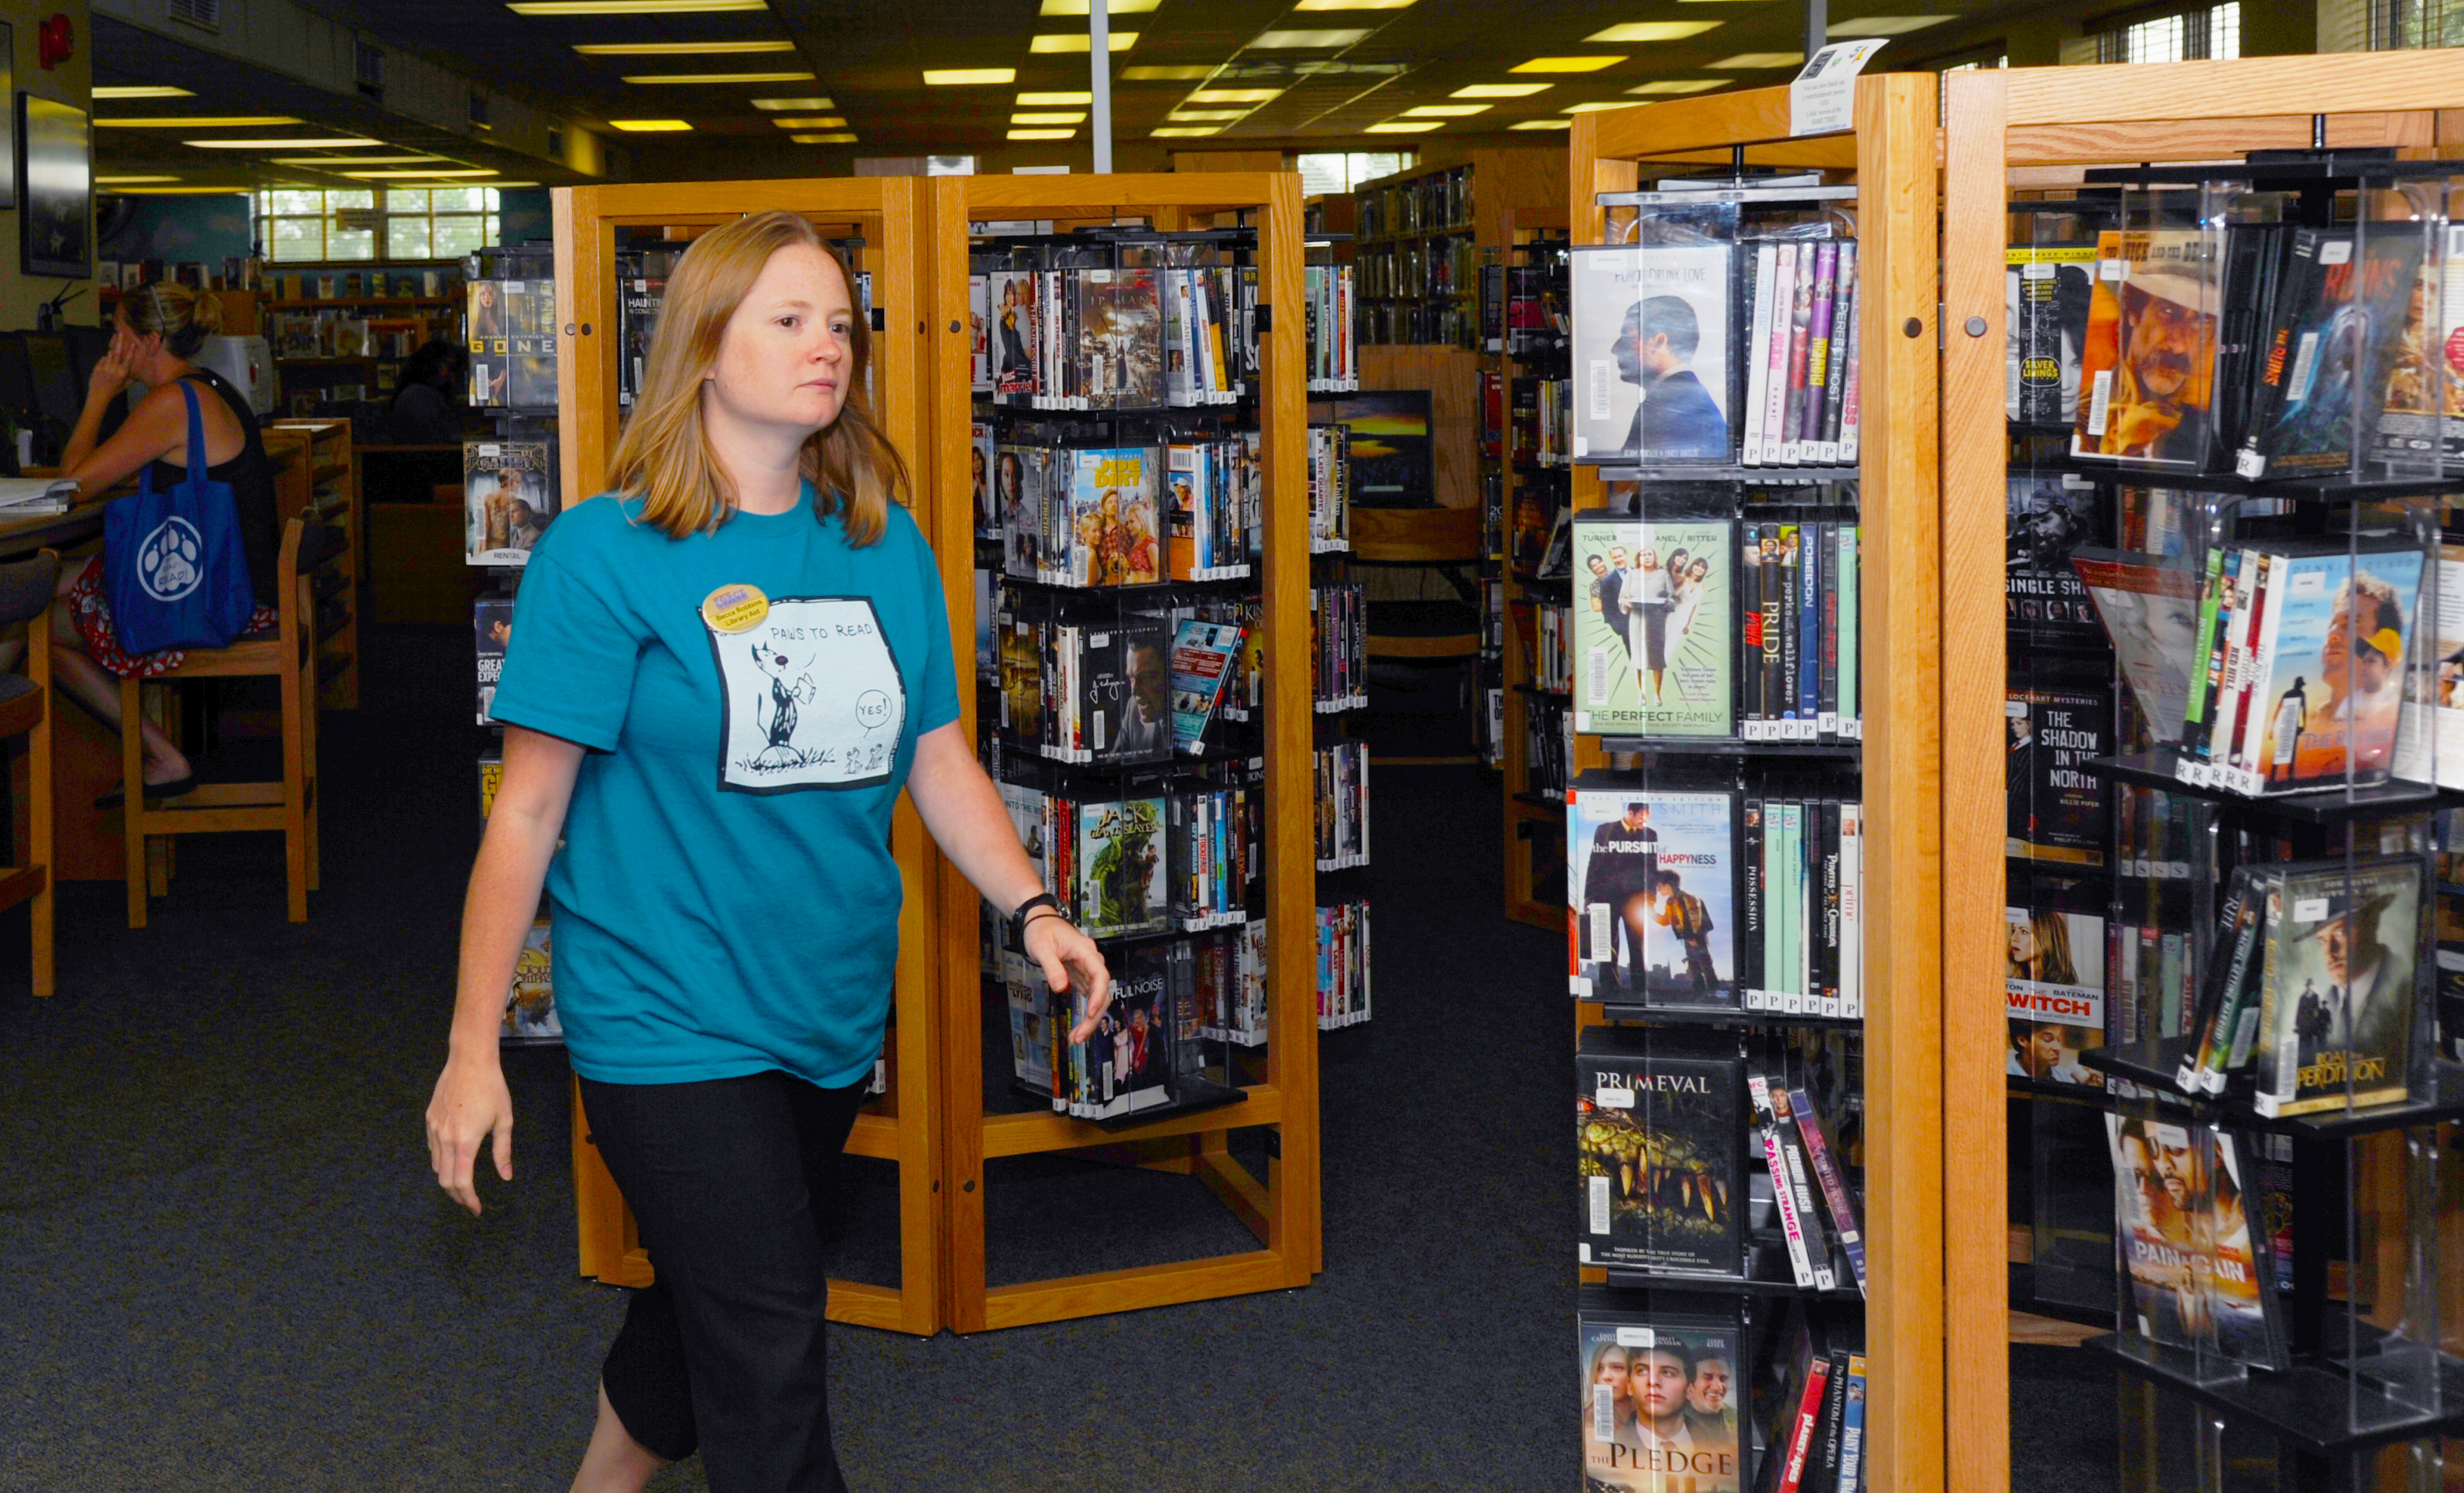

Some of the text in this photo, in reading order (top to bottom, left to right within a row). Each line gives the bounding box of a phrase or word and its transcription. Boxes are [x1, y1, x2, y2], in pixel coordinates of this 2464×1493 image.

[1683, 267, 1706, 282] LOVE
[1090, 295, 1105, 306] IP
[469, 340, 555, 354] GONE
[1828, 301, 1849, 404] PERFECT HOST
[1184, 347, 1193, 372] EYRE
[2025, 360, 2055, 369] SILVER
[1749, 448, 1757, 459] P
[1767, 447, 1775, 458] P
[1787, 448, 1796, 459] P
[1805, 445, 1814, 456] P
[1825, 447, 1833, 458] P
[1844, 442, 1852, 454] P
[1094, 459, 1142, 474] JOE
[2239, 457, 2250, 473] R
[1094, 472, 1143, 488] DIRT
[1804, 536, 1814, 608] POSEIDON
[2005, 579, 2056, 594] SINGLE
[716, 599, 763, 622] Becca Robbins
[725, 608, 761, 627] Library Aid
[770, 623, 873, 641] PAWS TO READ
[1763, 601, 1780, 664] PRIDE
[1783, 581, 1795, 704] perks wallflower
[2190, 617, 2206, 678] ROSEMARY'S
[2223, 646, 2240, 690] RED HILL
[858, 697, 888, 717] YES!
[2008, 693, 2099, 706] LOCKHART MYSTERIES
[1584, 710, 1723, 723] THE PERFECT FAMILY
[1826, 717, 1835, 728] P
[2047, 711, 2072, 728] THE
[1749, 725, 1757, 736] P
[1767, 725, 1777, 736] P
[1784, 724, 1793, 735] P
[1804, 724, 1812, 735] P
[1845, 723, 1853, 733] P
[2041, 729, 2098, 750] SHADOW
[2303, 731, 2332, 749] THE
[2055, 750, 2070, 765] IN
[2178, 764, 2186, 776] R
[2193, 767, 2202, 779] R
[2212, 768, 2221, 781] R
[2226, 771, 2235, 784] R
[2050, 769, 2097, 789] NORTH
[2240, 775, 2250, 789] R
[1098, 805, 1150, 827] JACK
[1660, 803, 1722, 815] SMITH
[1089, 822, 1158, 840] GIANT SLAYER
[1592, 841, 1609, 854] the
[1609, 841, 1658, 854] PURSUIT
[1659, 854, 1718, 865] HAPPYNESS
[1747, 865, 1756, 932] POSSESSION
[1826, 852, 1840, 948] PIRATES CARIBBEAN
[1840, 884, 1856, 922] prime
[1134, 977, 1163, 996] NOISE
[2214, 930, 2249, 1044] RACHEL GETTING MARRIED
[1749, 995, 1758, 1005] P
[1770, 995, 1778, 1006] P
[2053, 989, 2099, 1001] BATEMAN
[1789, 998, 1797, 1009] P
[1808, 999, 1817, 1010] P
[1825, 1002, 1834, 1014] P
[1846, 1003, 1856, 1014] P
[2005, 991, 2090, 1016] WITCH
[1595, 1071, 1712, 1094] PRIMEVAL
[2178, 1071, 2188, 1086] R
[2202, 1072, 2212, 1087] R
[2256, 1096, 2265, 1111] R
[1785, 1145, 1812, 1214] PREMIUM RUSH
[1763, 1139, 1801, 1241] PASSING STRANGE
[1830, 1187, 1845, 1215] HOUSE
[2134, 1239, 2246, 1284] PAIN GAIN
[1801, 1272, 1810, 1282] P
[1821, 1274, 1829, 1286] P
[1835, 1365, 1844, 1376] The
[1830, 1376, 1843, 1421] PHANTOM
[1787, 1413, 1815, 1484] PLANET APES
[1826, 1438, 1837, 1468] OPERA
[1842, 1426, 1861, 1476] PAINT YOUR
[1591, 1442, 1732, 1476] THE PLEDGE
